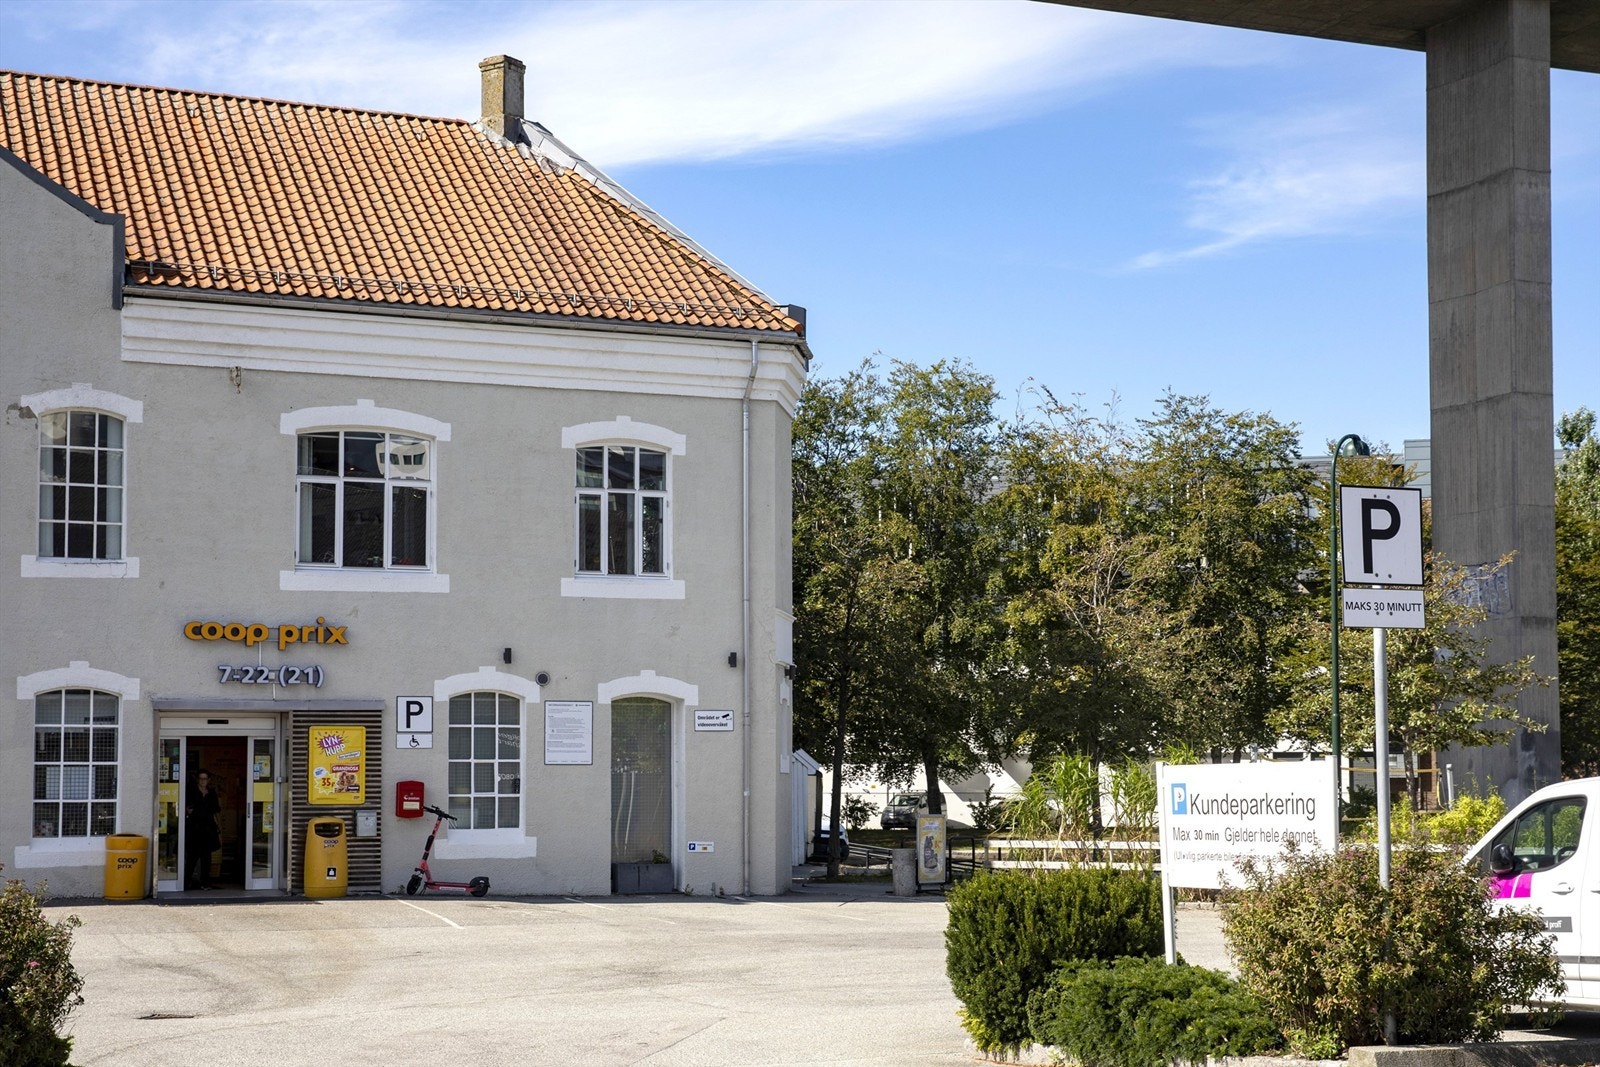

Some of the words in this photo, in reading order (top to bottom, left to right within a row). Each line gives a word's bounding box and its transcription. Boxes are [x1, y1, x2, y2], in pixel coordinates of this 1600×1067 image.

[1361, 498, 1401, 574] P
[1345, 601, 1372, 611] MAKS
[1373, 602, 1385, 611] 30
[1387, 603, 1422, 612] MINUTT
[184, 621, 269, 647] coop
[278, 616, 349, 650] prix
[278, 665, 324, 687] (21)
[406, 701, 424, 729] P
[1190, 793, 1316, 821] Kundeparkering
[1173, 827, 1191, 841] Max
[1194, 829, 1203, 841] 30
[1205, 830, 1220, 841] min
[1224, 827, 1258, 845] Gjelder
[1260, 828, 1280, 842] hele
[1197, 851, 1222, 861] parkerte
